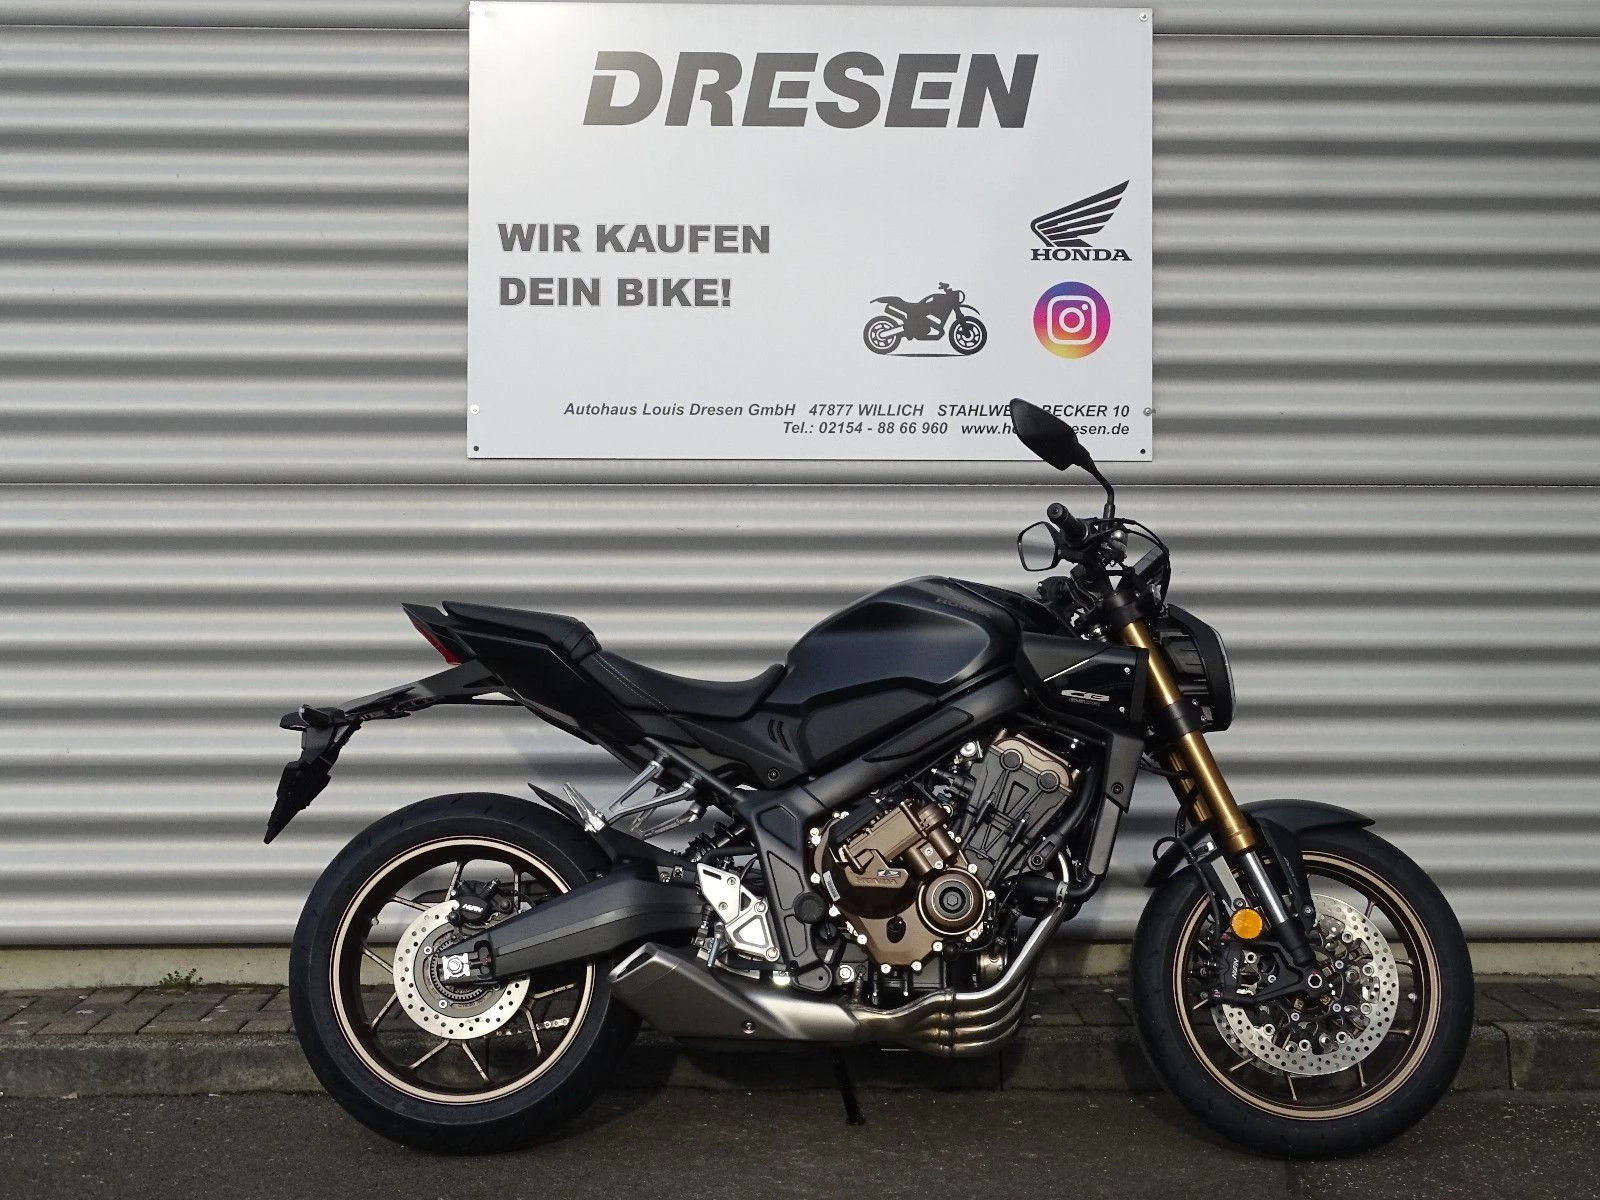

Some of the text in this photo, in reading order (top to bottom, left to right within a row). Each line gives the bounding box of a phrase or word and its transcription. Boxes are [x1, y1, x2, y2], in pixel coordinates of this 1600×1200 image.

[583, 51, 1039, 129] DRESEN
[497, 223, 770, 254] WIR KAUFEN
[1030, 248, 1133, 262] HONDA
[500, 277, 731, 307] DEIN BIKE!
[563, 402, 638, 416] Autohaus
[642, 402, 685, 416] Louis
[689, 403, 743, 416] Dresen
[748, 403, 796, 416] GmbH
[808, 403, 854, 416] 47877
[858, 403, 925, 417] WILLICH
[937, 404, 1013, 417] STAHLWE
[1113, 404, 1130, 418] 10
[783, 421, 814, 434] Tel.:
[818, 421, 863, 434] 02154
[877, 421, 895, 434] 88
[899, 421, 917, 434] 66
[921, 421, 948, 435] 960
